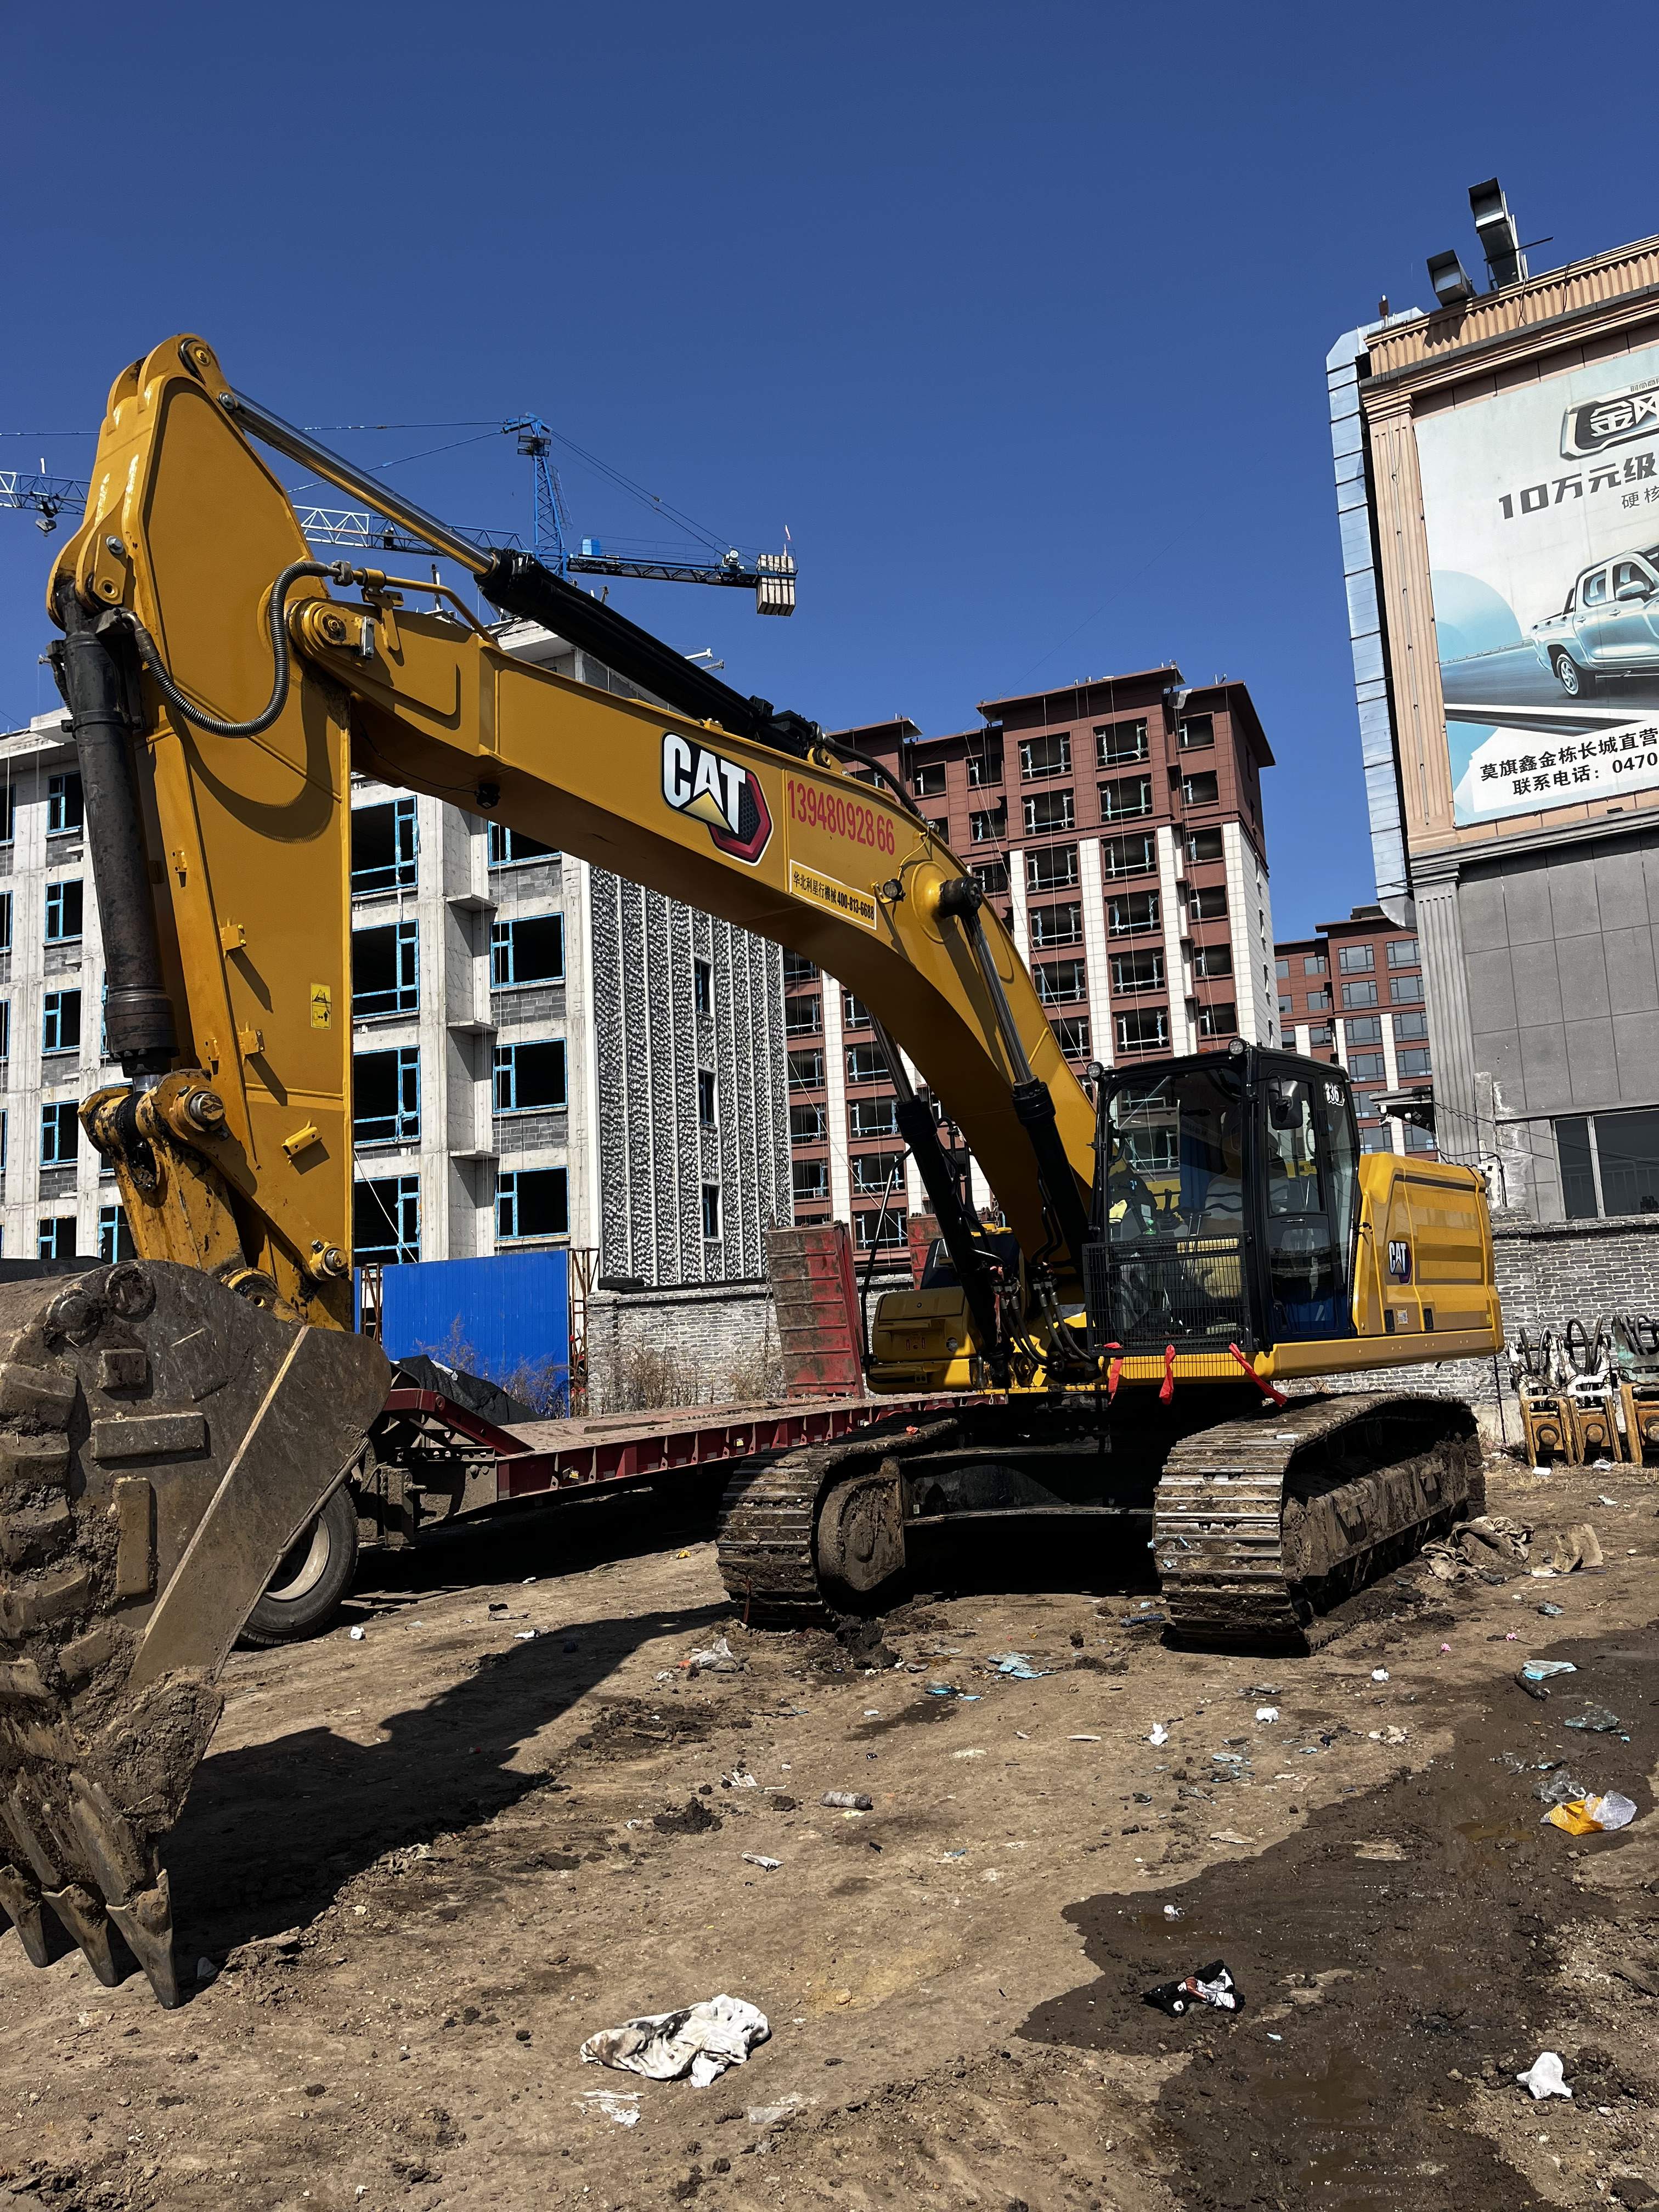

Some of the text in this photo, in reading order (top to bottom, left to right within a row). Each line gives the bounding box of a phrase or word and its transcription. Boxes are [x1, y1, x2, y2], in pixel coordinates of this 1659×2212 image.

[1498, 452, 1658, 520] 10万元级
[664, 734, 746, 834] CAT
[1480, 727, 1658, 782] 莫旗鑫金栋长城直营
[1612, 752, 1658, 773] 0470
[787, 780, 895, 855] 13948092866
[1389, 1242, 1406, 1273] CAT
